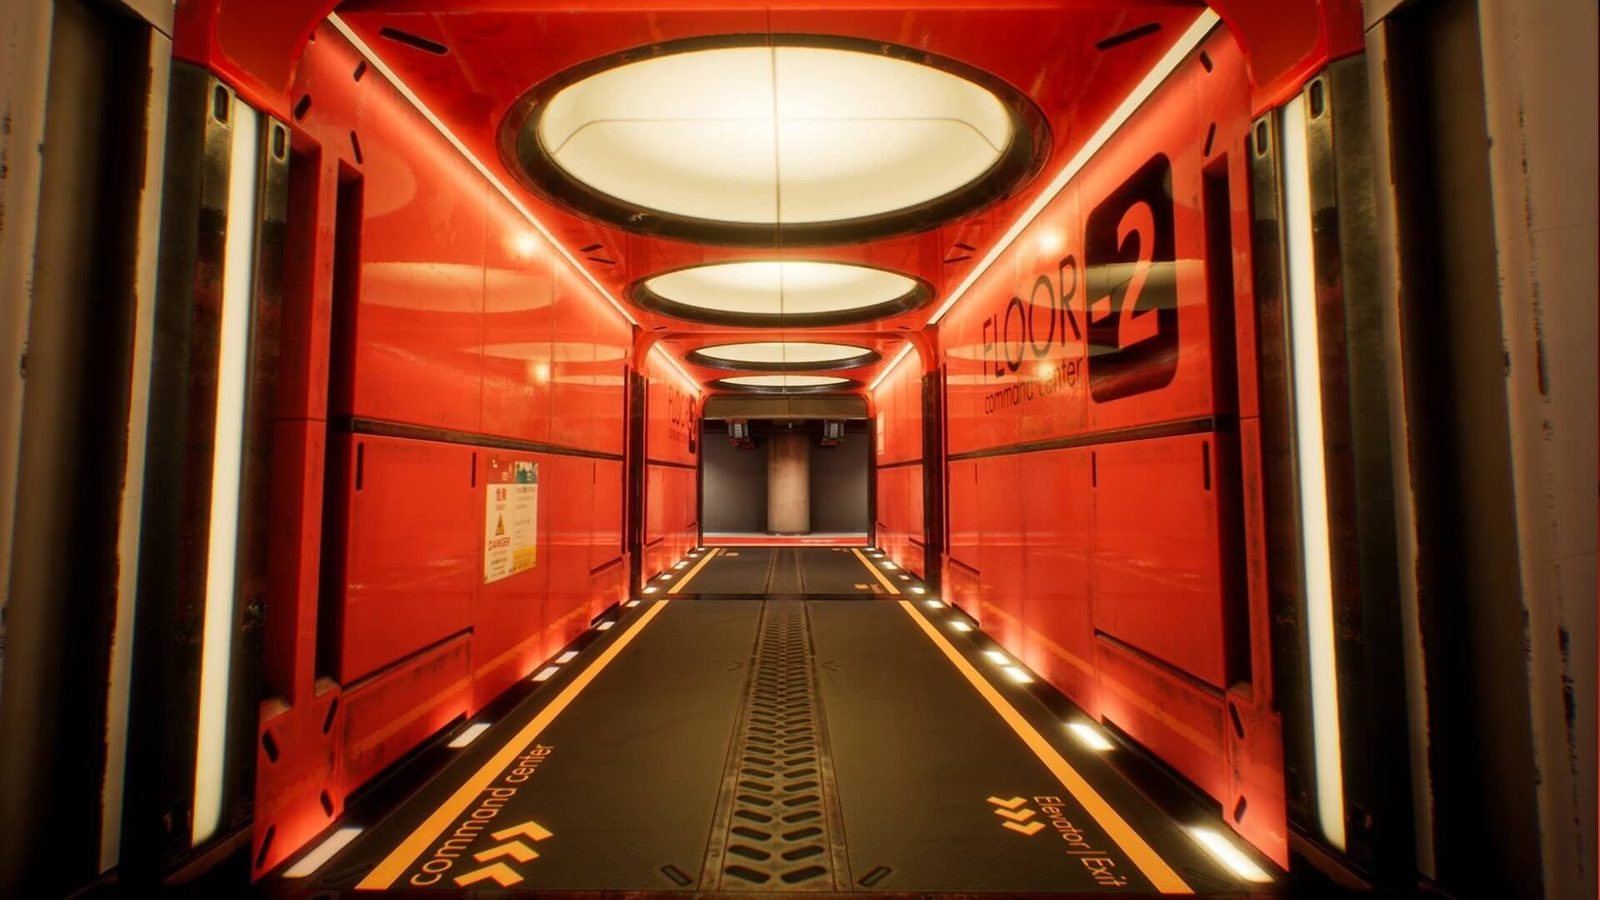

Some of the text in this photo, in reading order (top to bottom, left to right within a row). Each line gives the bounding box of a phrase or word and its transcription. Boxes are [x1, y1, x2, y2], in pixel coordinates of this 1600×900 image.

[983, 255, 1082, 384] FLOOR
[984, 374, 1034, 415] command
[410, 743, 554, 886] command center
[1033, 796, 1091, 849] Elevator
[1080, 857, 1128, 887] Exit
